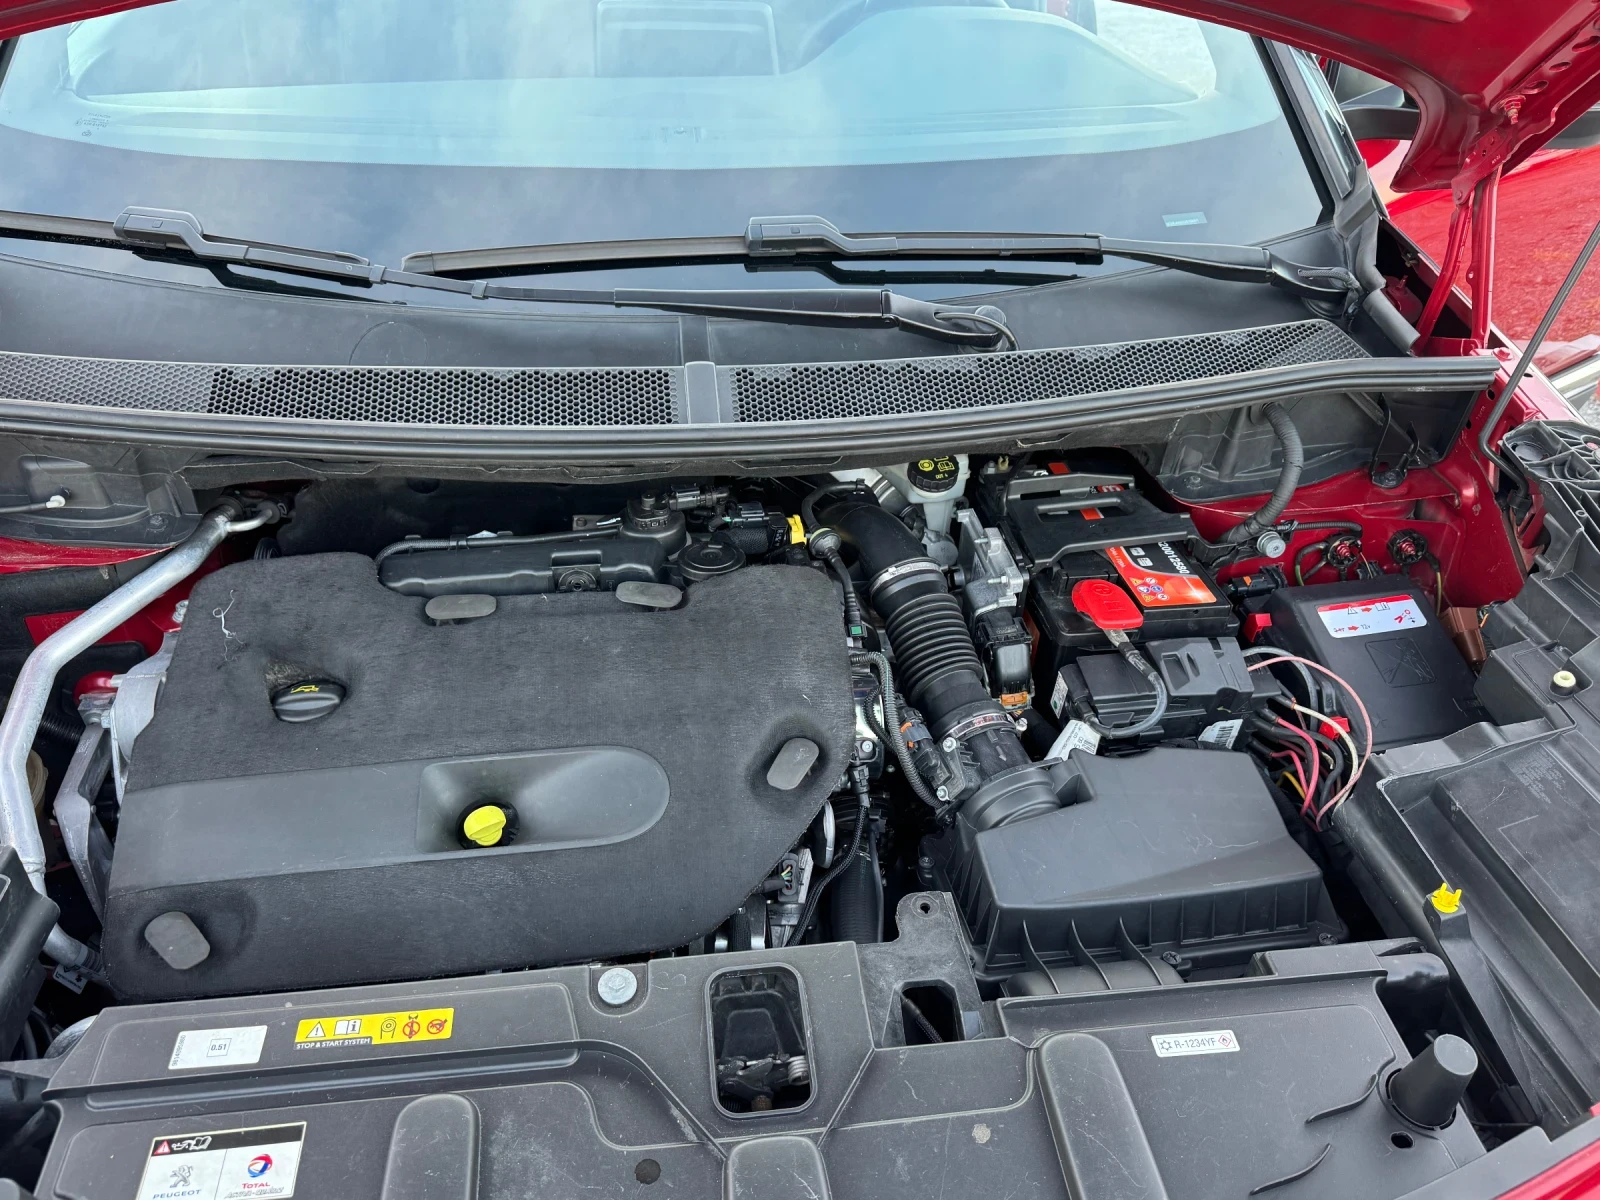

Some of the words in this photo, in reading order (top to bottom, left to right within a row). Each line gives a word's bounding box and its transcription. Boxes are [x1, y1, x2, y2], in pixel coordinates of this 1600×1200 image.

[344, 1038, 371, 1046] SYSTEM
[1173, 1037, 1217, 1049] R-1234YF
[210, 1043, 227, 1051] 0.51
[242, 1181, 271, 1189] TOTAL
[152, 1188, 203, 1200] PEUGEOT
